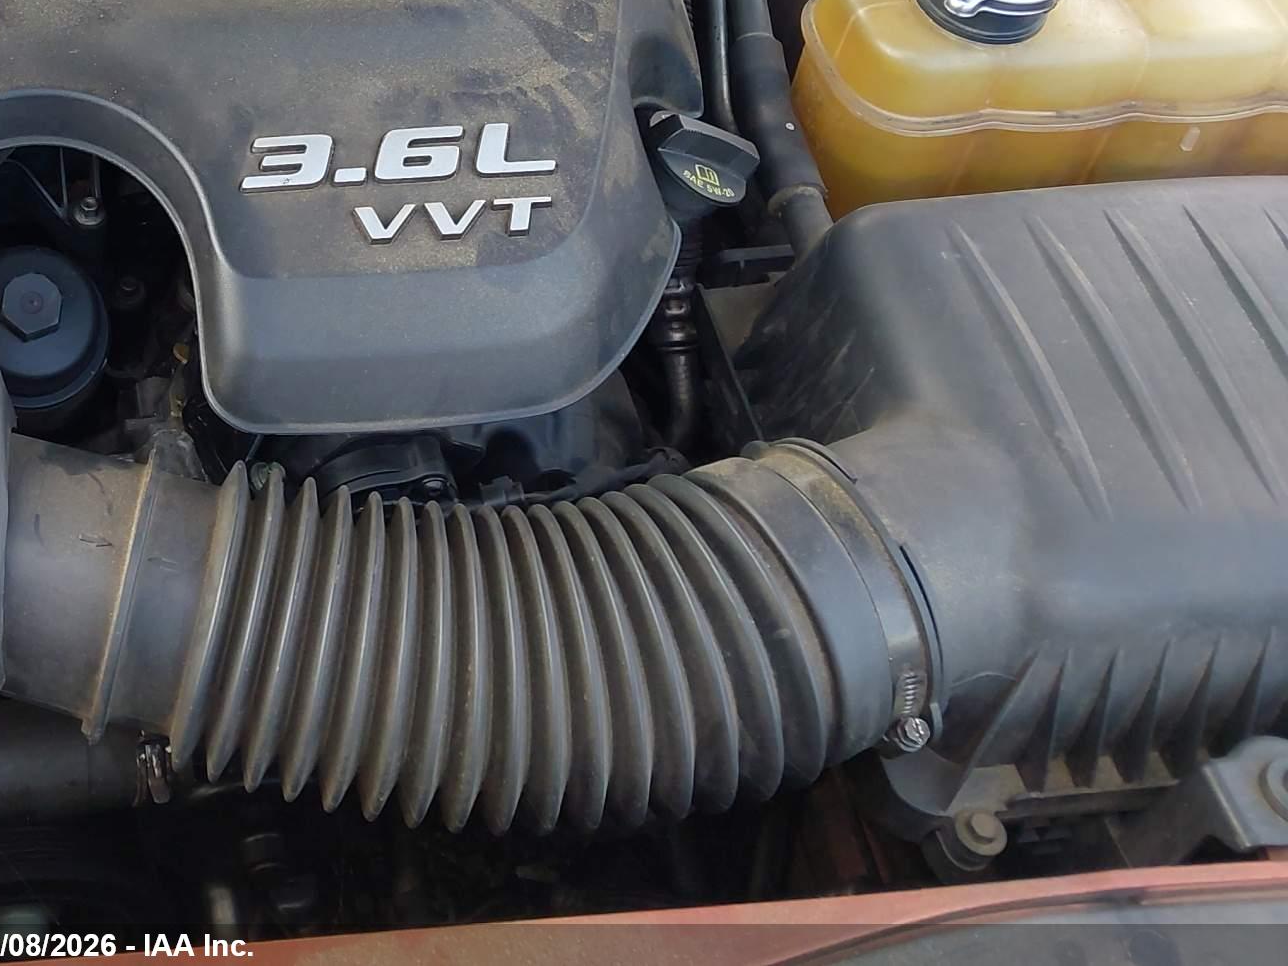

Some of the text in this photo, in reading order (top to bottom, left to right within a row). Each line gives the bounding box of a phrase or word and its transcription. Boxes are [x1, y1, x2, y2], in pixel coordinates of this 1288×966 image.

[240, 122, 558, 194] 3.6L
[682, 169, 735, 198] SAE 5W-20
[353, 195, 552, 245] VVT
